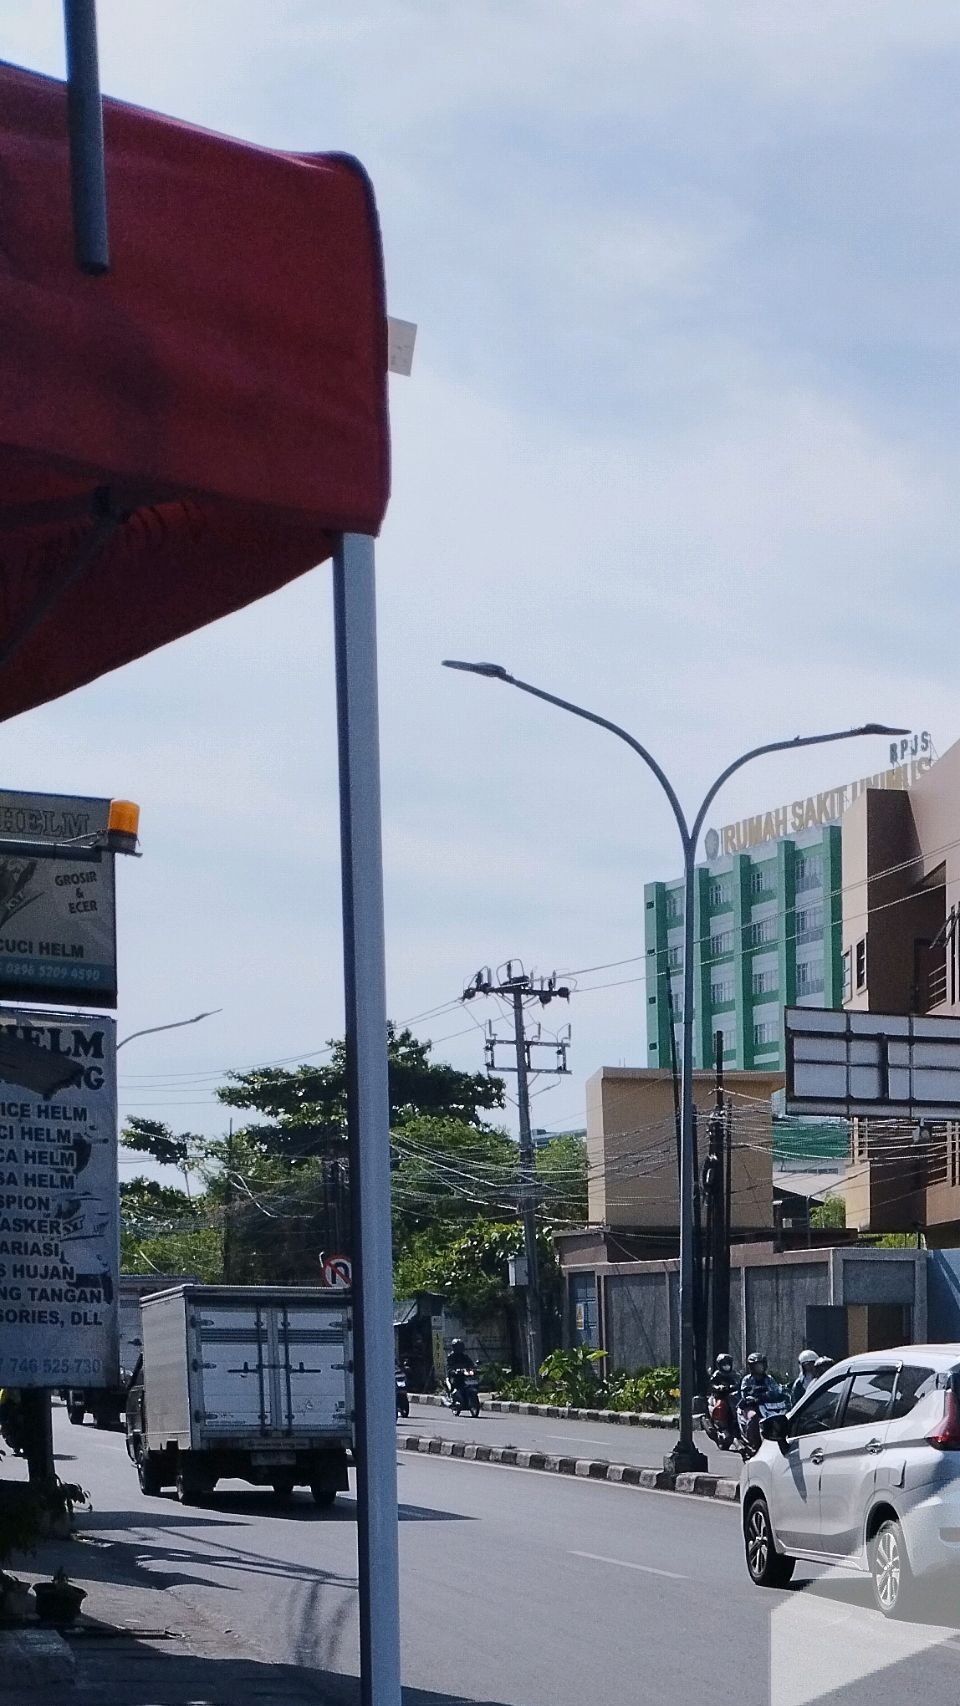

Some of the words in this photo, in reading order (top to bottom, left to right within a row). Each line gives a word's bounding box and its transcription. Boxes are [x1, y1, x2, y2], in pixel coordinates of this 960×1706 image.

[722, 805, 788, 856] RUMAH
[791, 785, 848, 832] SAKIT
[55, 871, 97, 886] GROSIR
[76, 887, 84, 899] &
[68, 901, 98, 914] ECER
[39, 942, 84, 958] HELM
[37, 1104, 87, 1121] HELM
[21, 1126, 71, 1143] HELM
[24, 1149, 75, 1166] HELM
[24, 1172, 74, 1189] HELM
[13, 1263, 74, 1280] HUJAN
[28, 1287, 101, 1304] TANGAN
[71, 1311, 102, 1325] DLL
